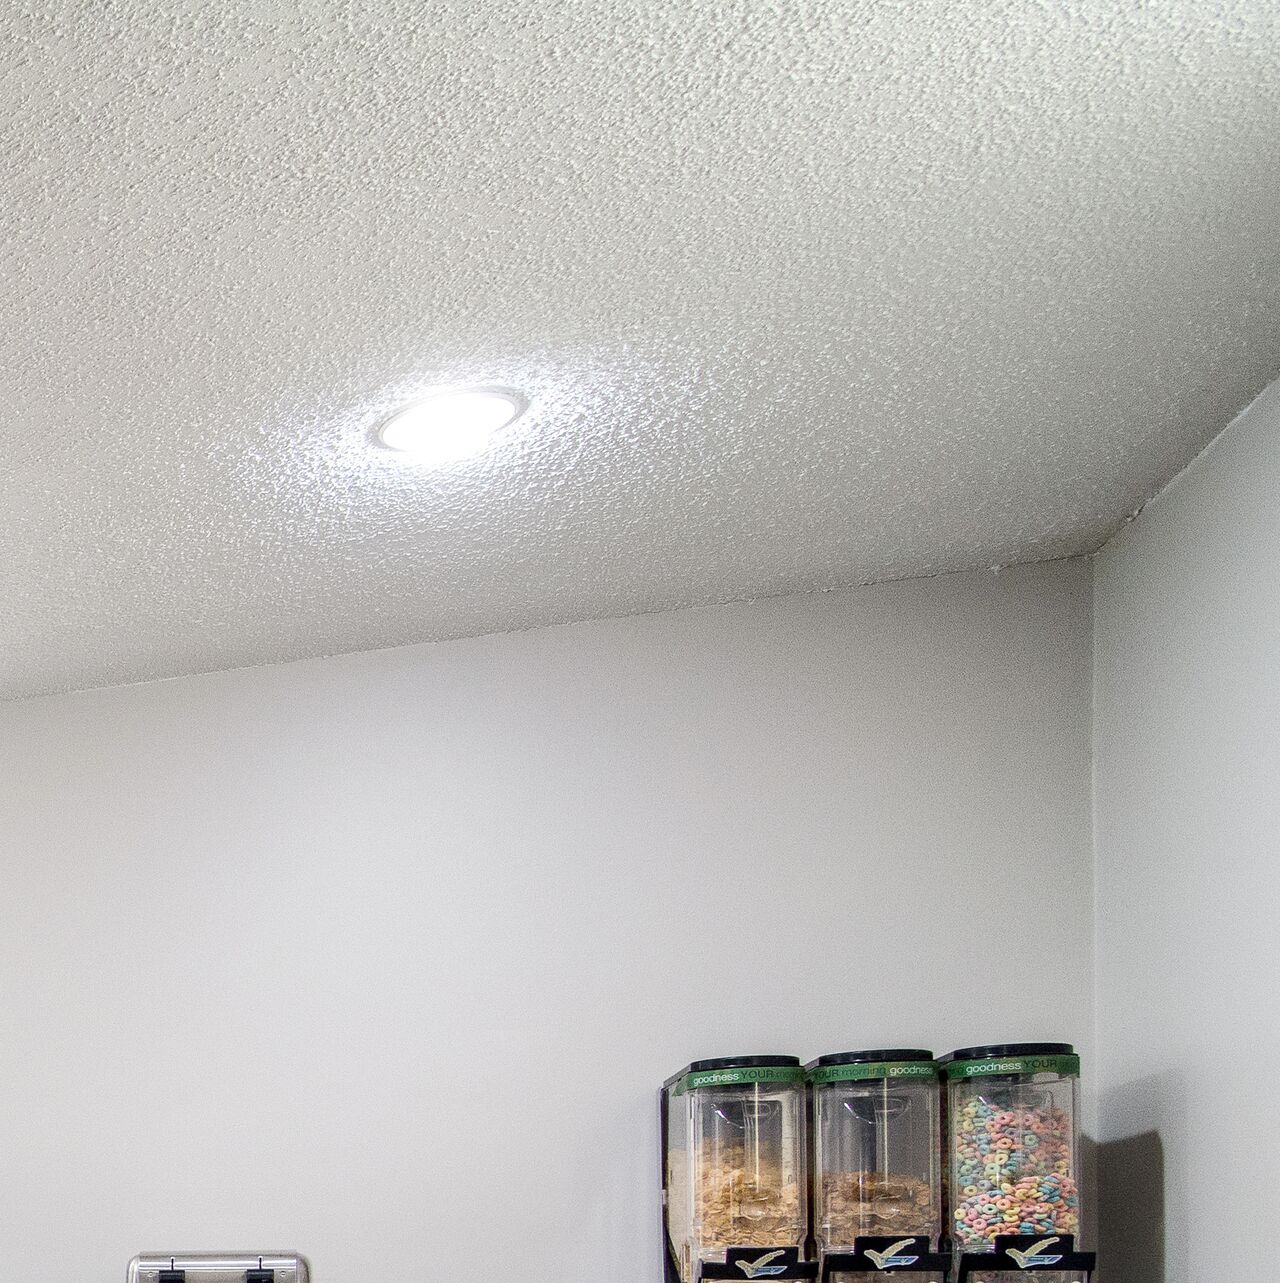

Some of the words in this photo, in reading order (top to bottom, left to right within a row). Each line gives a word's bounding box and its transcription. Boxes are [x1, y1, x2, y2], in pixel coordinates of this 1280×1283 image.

[889, 1065, 933, 1076] goodness
[965, 1062, 1022, 1076] goodness
[1024, 1059, 1057, 1069] YOUR
[693, 1073, 740, 1087] goodness
[741, 1069, 774, 1080] YOUR
